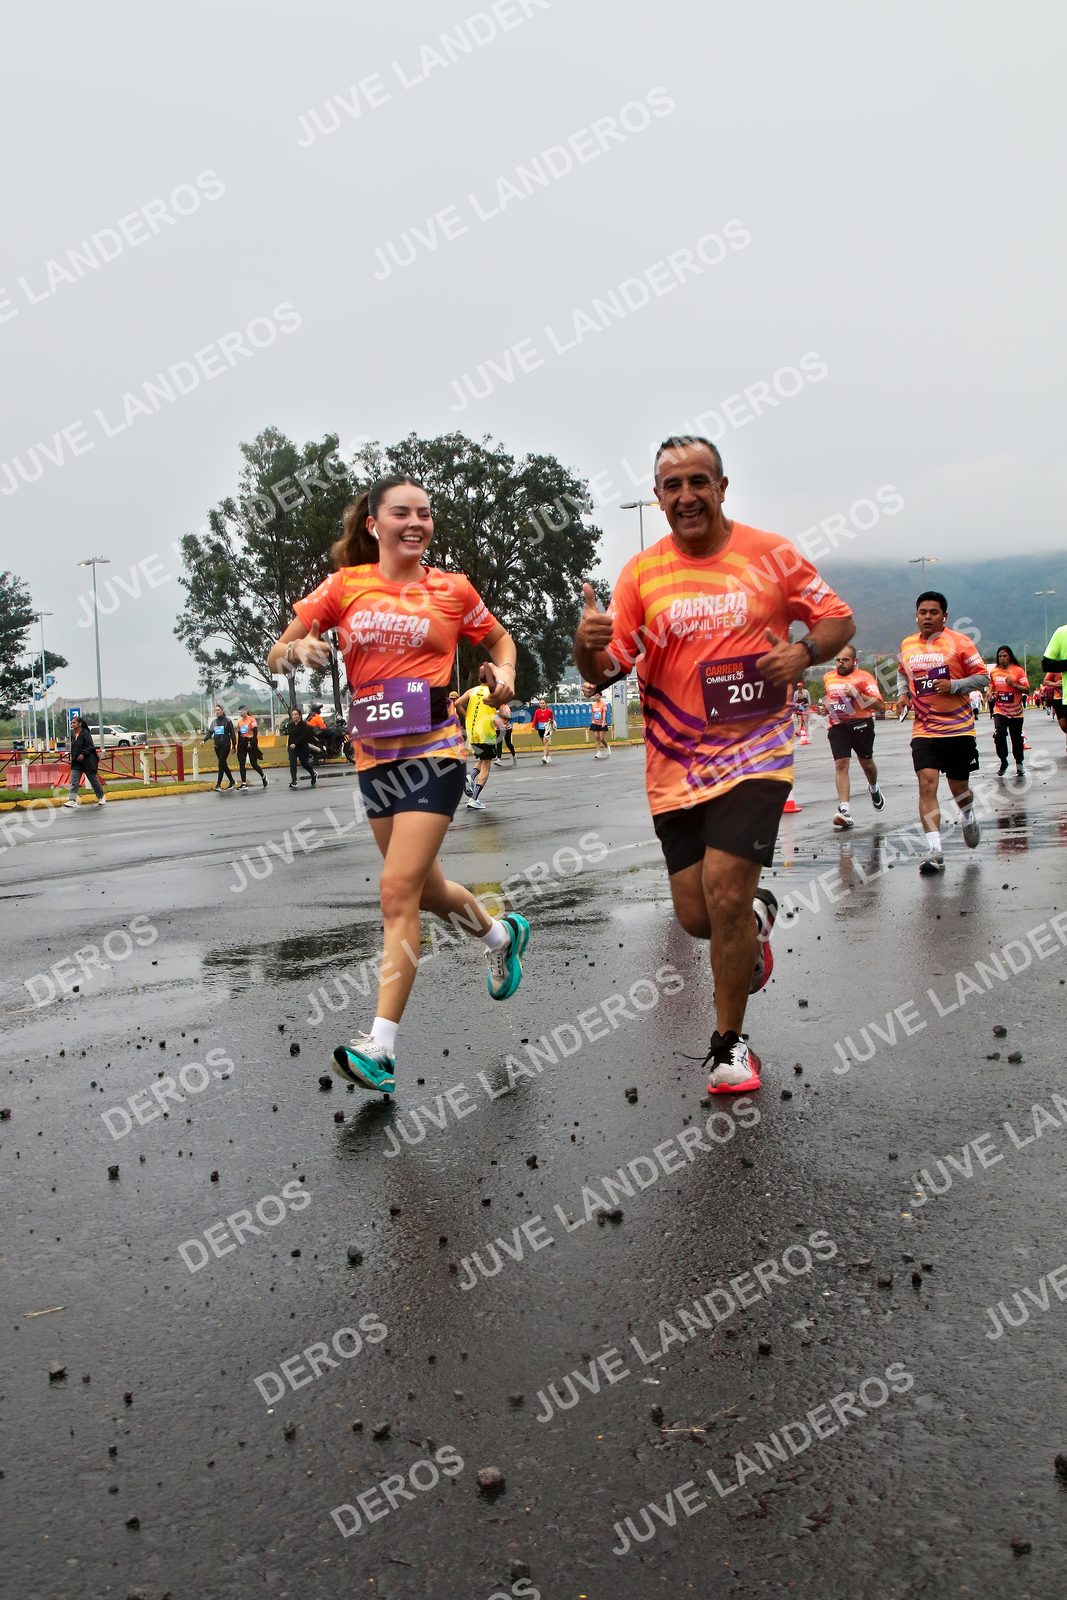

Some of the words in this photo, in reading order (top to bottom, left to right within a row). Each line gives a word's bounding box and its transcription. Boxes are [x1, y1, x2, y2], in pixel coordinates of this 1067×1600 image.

[670, 592, 748, 620] CARRERA
[350, 611, 430, 635] CARRERA
[671, 615, 730, 634] OMNILIFE
[350, 632, 406, 646] OMNILIFE
[910, 653, 944, 664] CARRERA
[706, 662, 744, 677] CARRERA
[706, 673, 736, 684] OMNILIFE
[922, 679, 938, 689] 76
[728, 680, 764, 704] 207
[366, 702, 404, 722] 256
